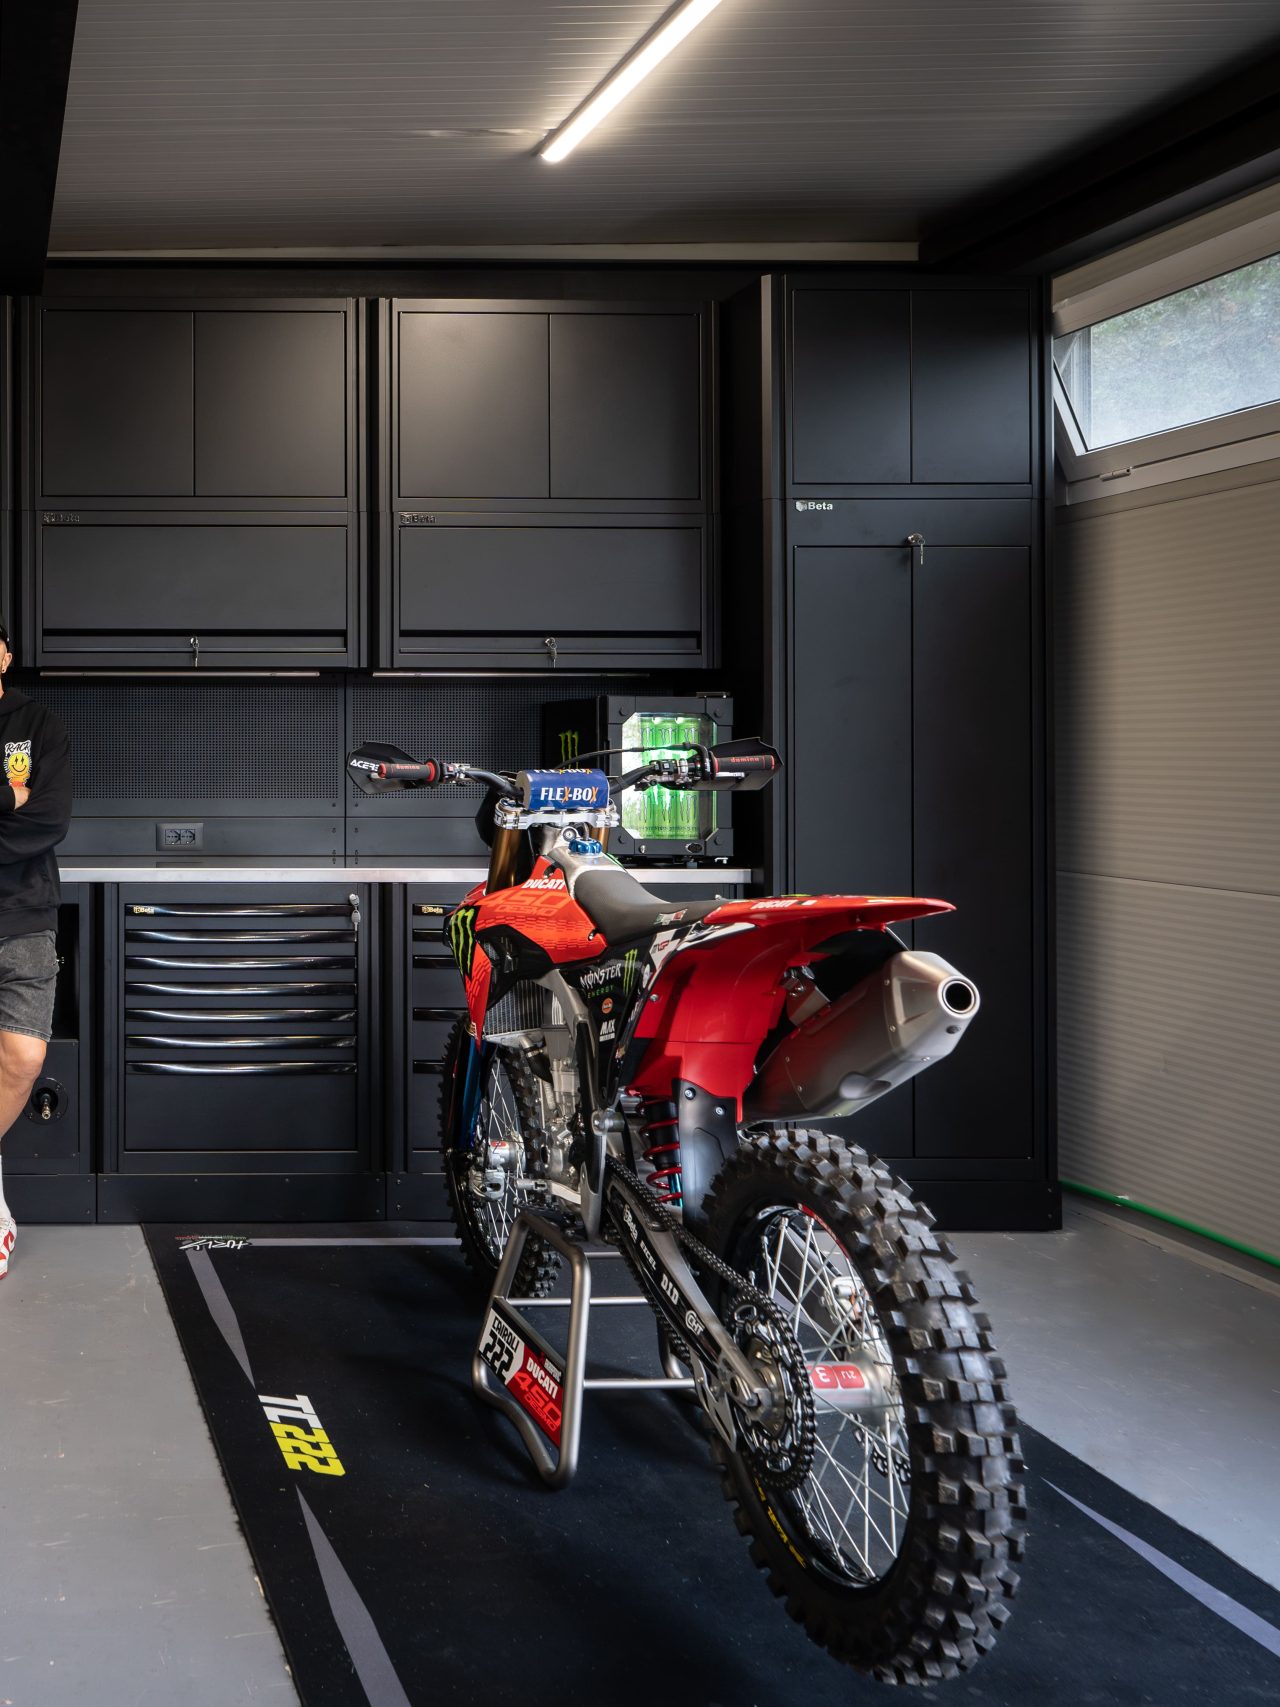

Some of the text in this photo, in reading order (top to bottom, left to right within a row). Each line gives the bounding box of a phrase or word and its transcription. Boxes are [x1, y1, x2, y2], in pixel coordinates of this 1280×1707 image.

[808, 501, 833, 511] Beta
[540, 786, 599, 804] FLEX-BOX
[521, 878, 566, 890] DUCATI
[484, 889, 571, 909] 450
[494, 905, 557, 917] DESMO
[580, 963, 622, 990] MONSTER
[587, 984, 614, 999] ENERGY
[639, 1240, 657, 1271] EXCEL
[492, 1315, 520, 1354] CAIROLI
[483, 1327, 514, 1386] 222
[526, 1357, 559, 1399] DUCATI
[513, 1371, 561, 1427] 450
[523, 1394, 557, 1432] DESMO
[257, 1394, 347, 1477] TC222
